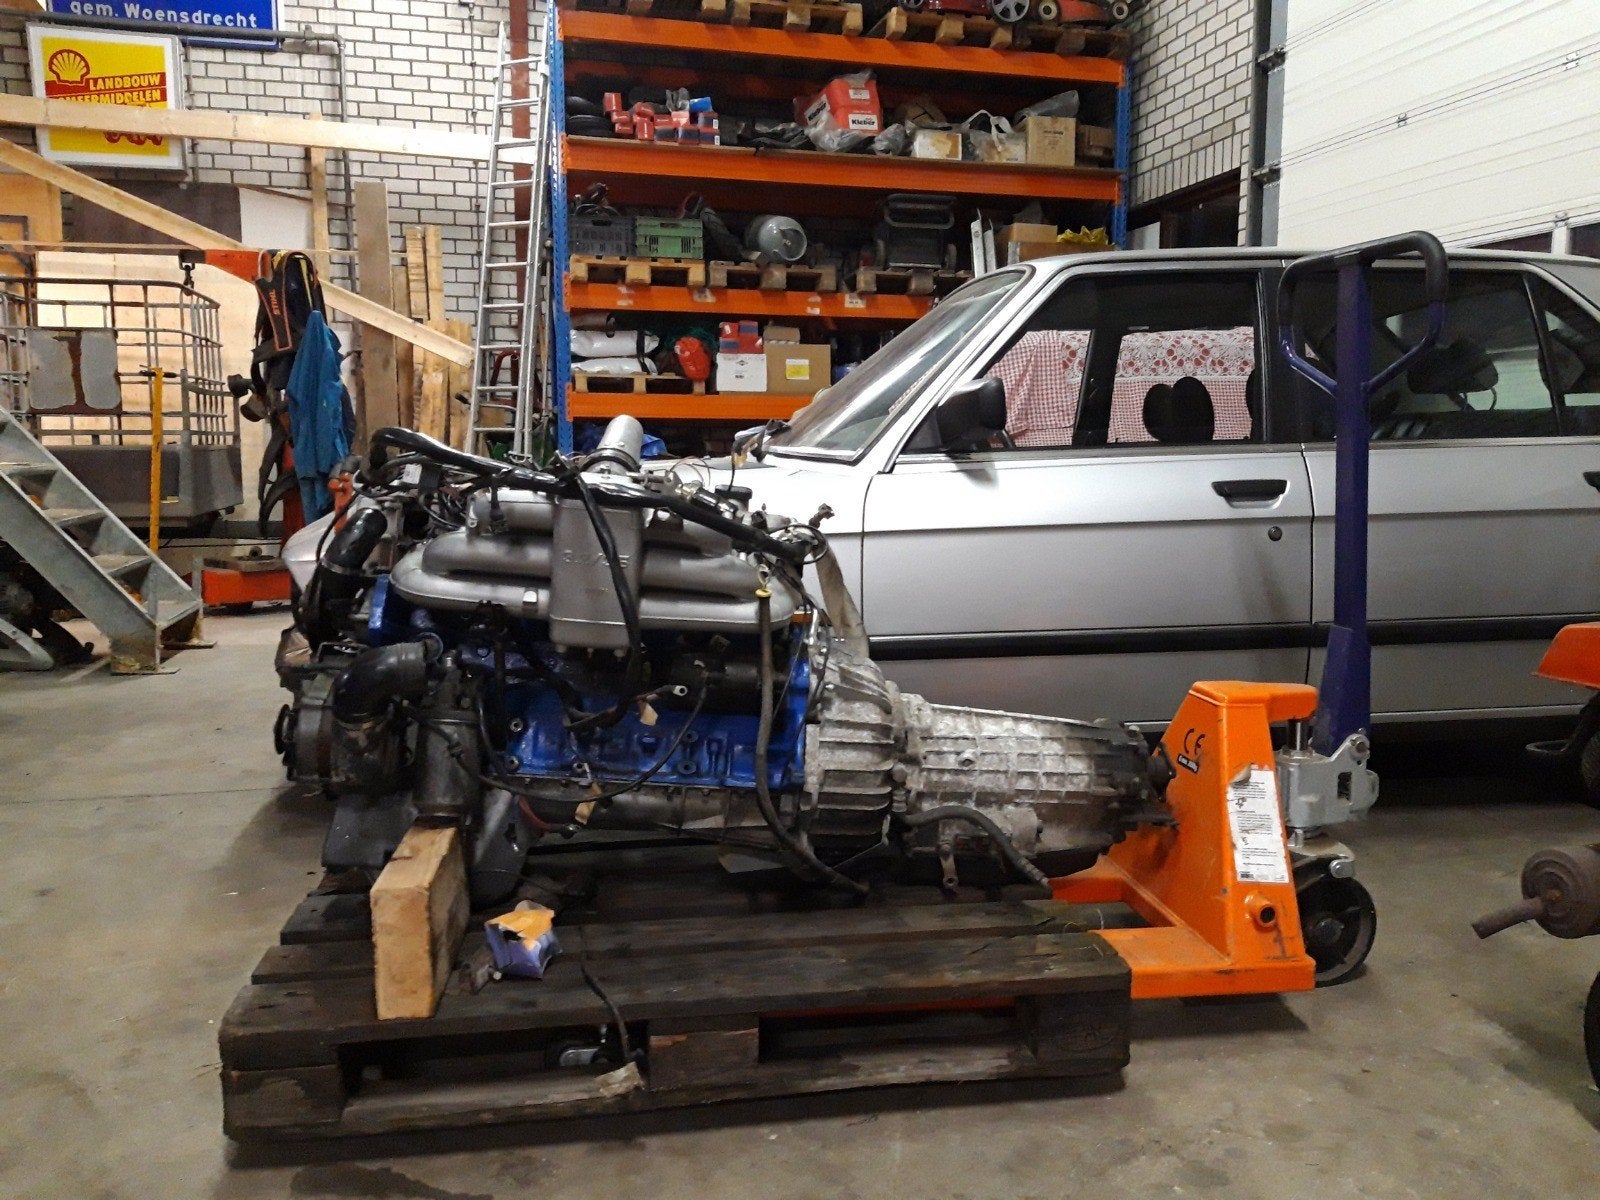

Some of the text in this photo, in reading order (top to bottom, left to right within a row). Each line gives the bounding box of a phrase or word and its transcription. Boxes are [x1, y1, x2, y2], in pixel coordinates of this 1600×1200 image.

[70, 1, 257, 28] gem. Woensdrecht
[89, 74, 161, 91] LANDBOUW
[58, 89, 161, 105] EERMIDDELEN
[851, 118, 876, 126] Kleber
